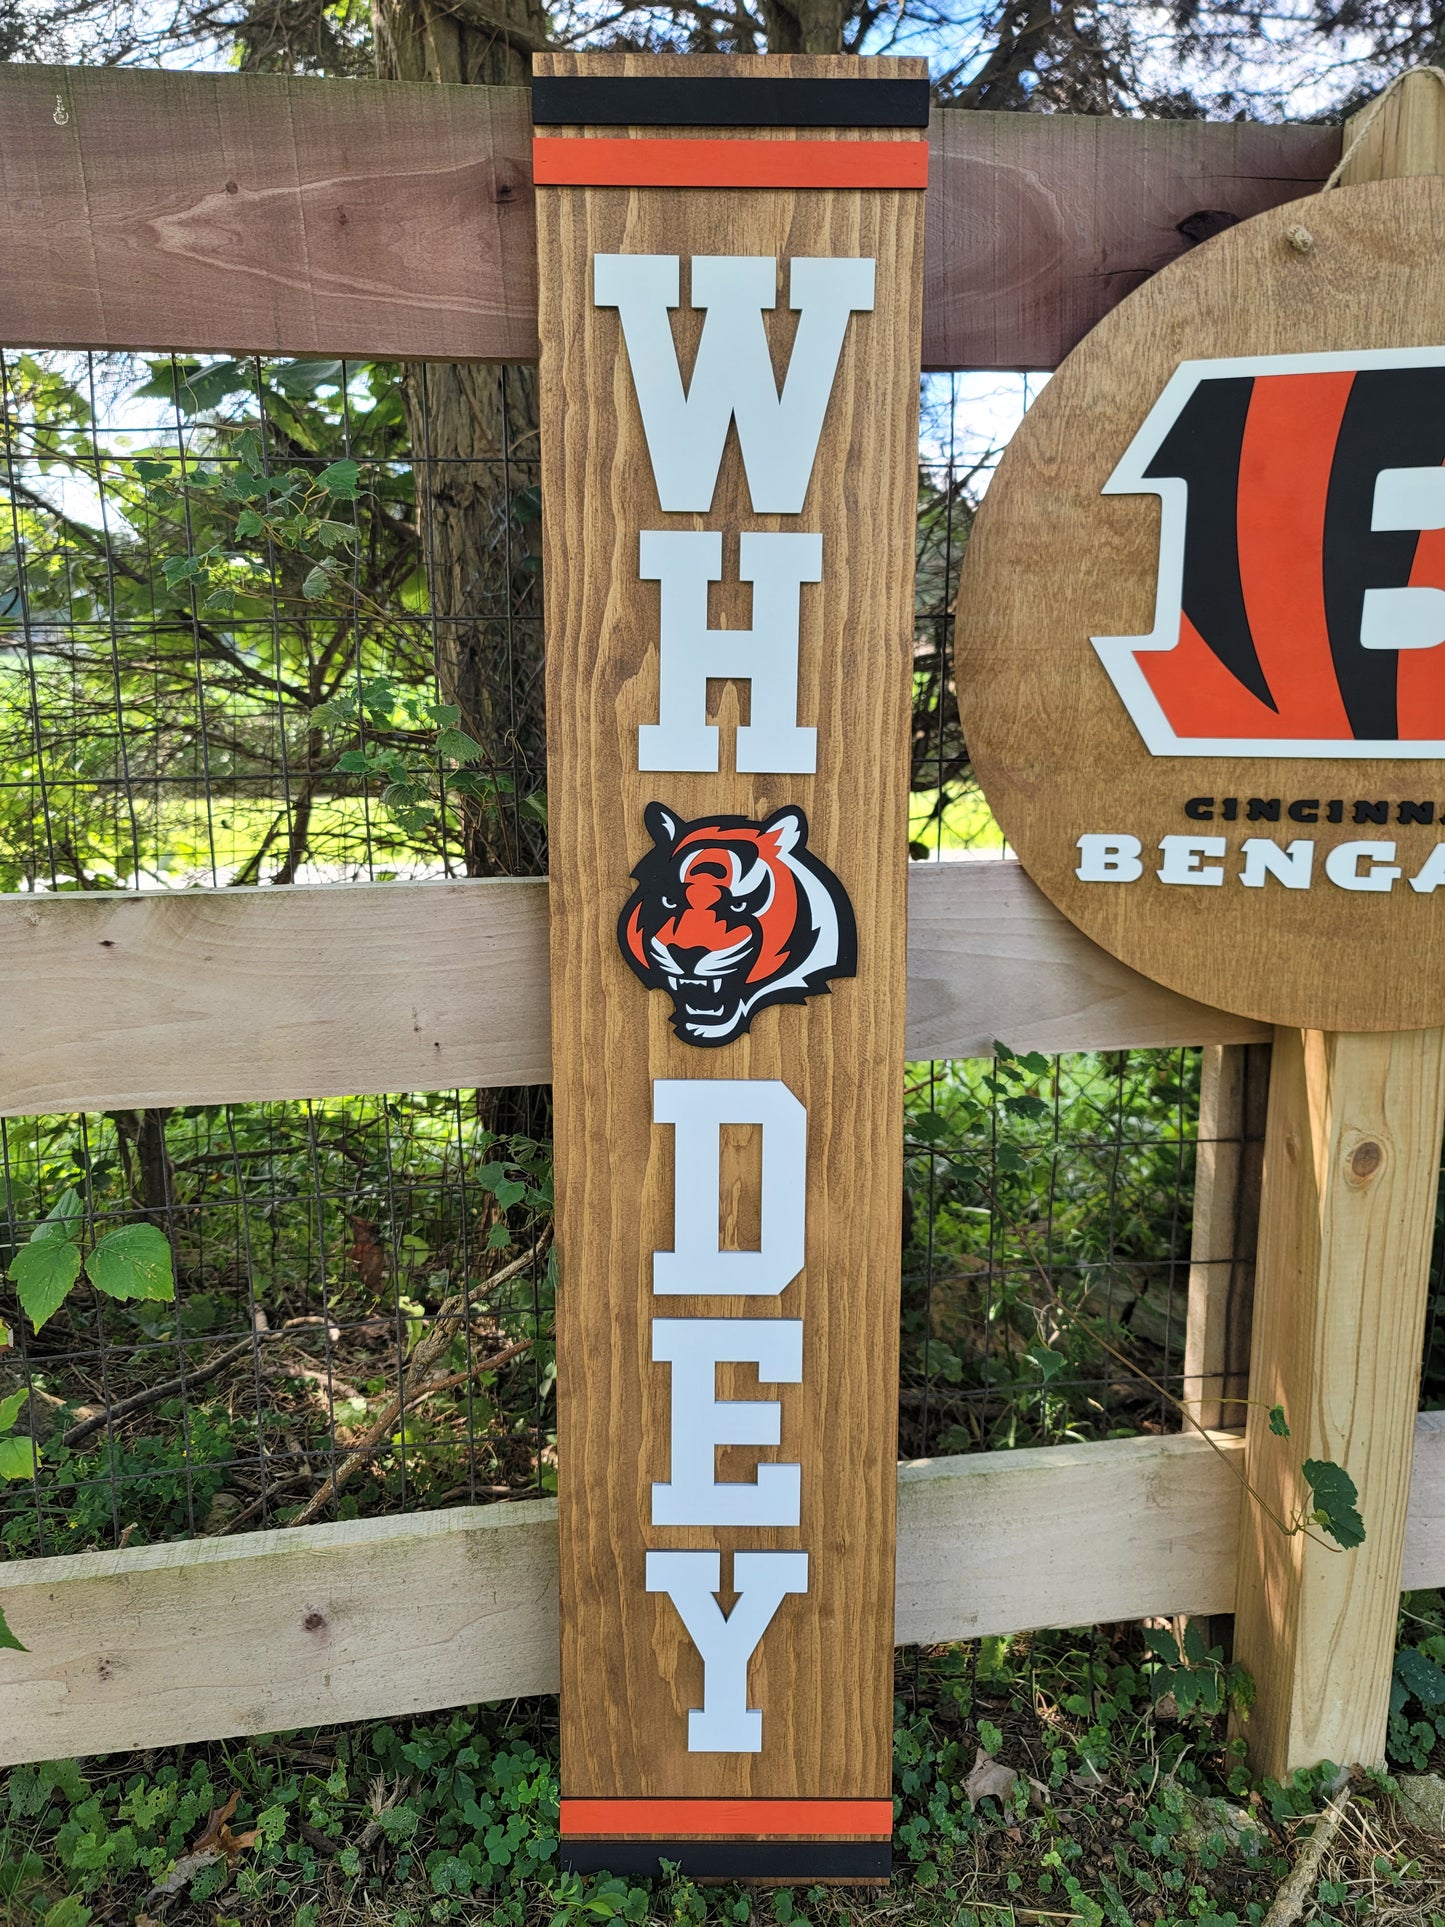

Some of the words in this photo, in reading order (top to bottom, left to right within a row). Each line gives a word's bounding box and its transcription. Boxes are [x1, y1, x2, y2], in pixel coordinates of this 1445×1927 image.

[594, 253, 876, 774] WH
[1184, 797, 1445, 825] CINCINN
[645, 1078, 809, 1752] DEY
